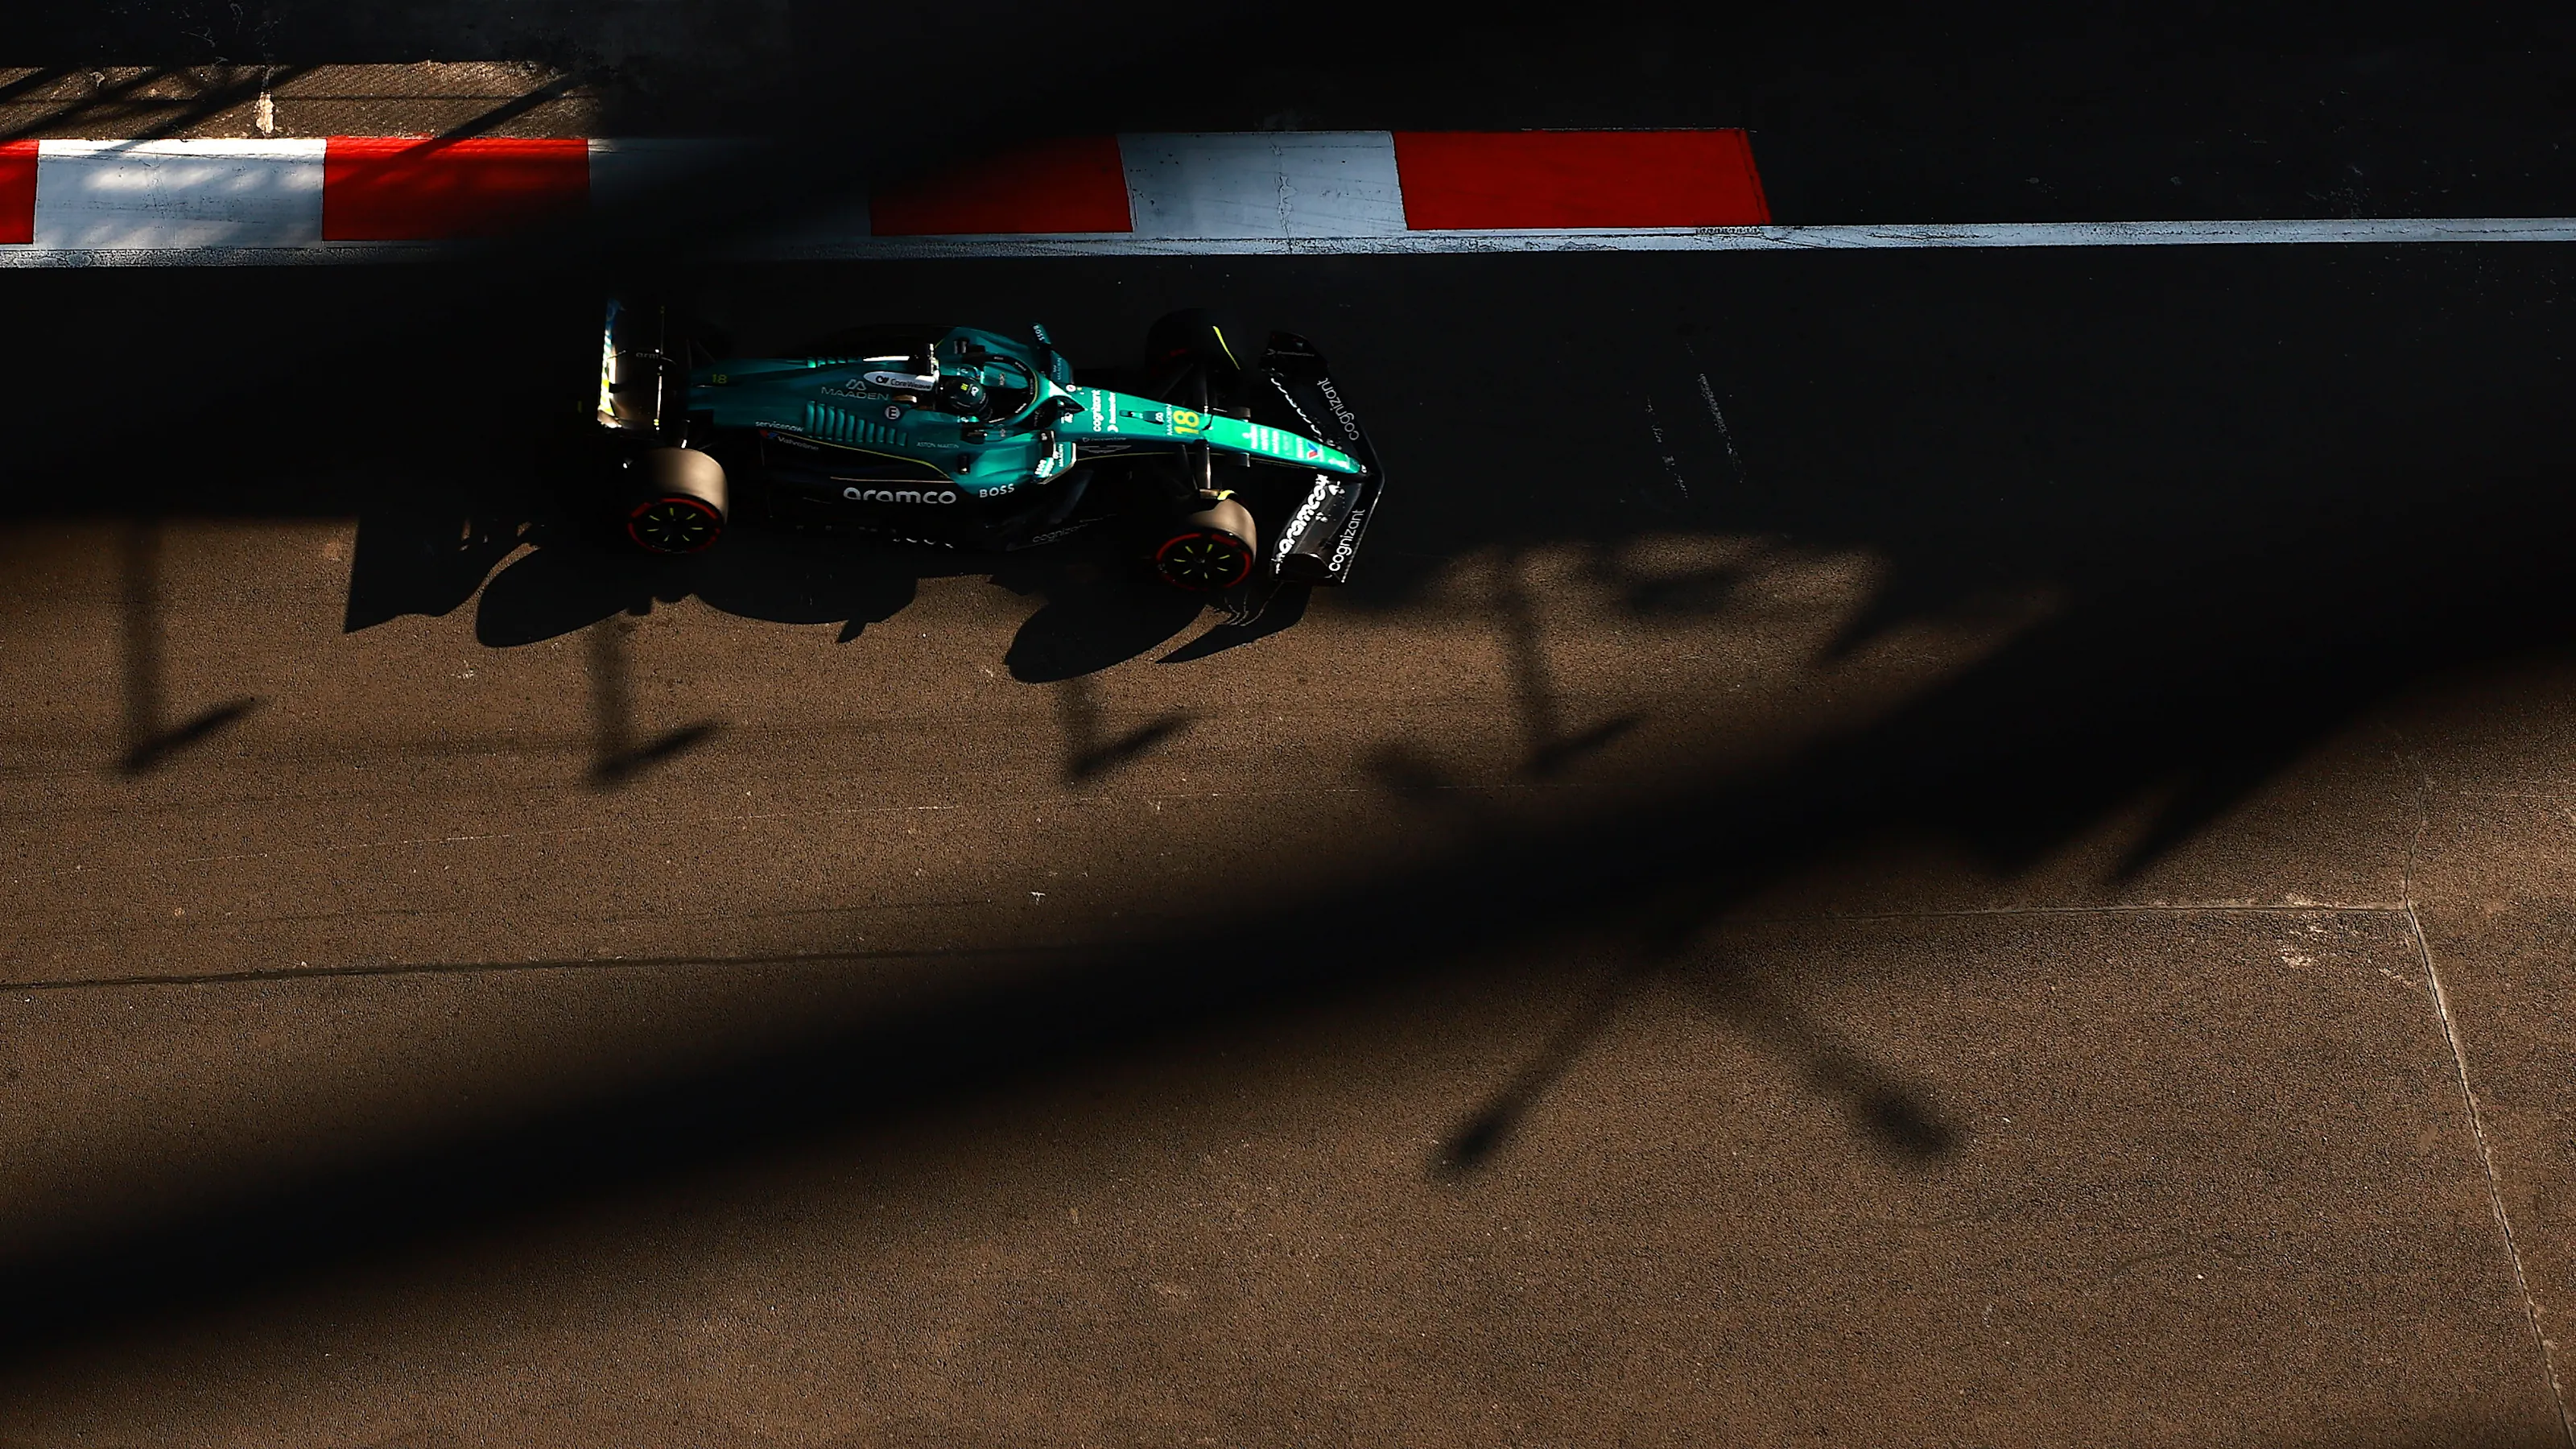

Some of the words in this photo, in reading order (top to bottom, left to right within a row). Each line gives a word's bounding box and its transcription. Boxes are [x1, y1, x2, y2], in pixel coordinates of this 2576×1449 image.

[712, 374, 728, 384] 18
[820, 386, 889, 401] MAADEN
[1091, 389, 1104, 432] cognizant
[1316, 378, 1360, 440] cognizant
[755, 421, 804, 433] servicenow
[1172, 410, 1199, 435] 18
[843, 486, 957, 505] aramco
[979, 483, 1015, 498] BOSS
[1279, 484, 1326, 554] aramco
[1330, 509, 1366, 572] cognizant
